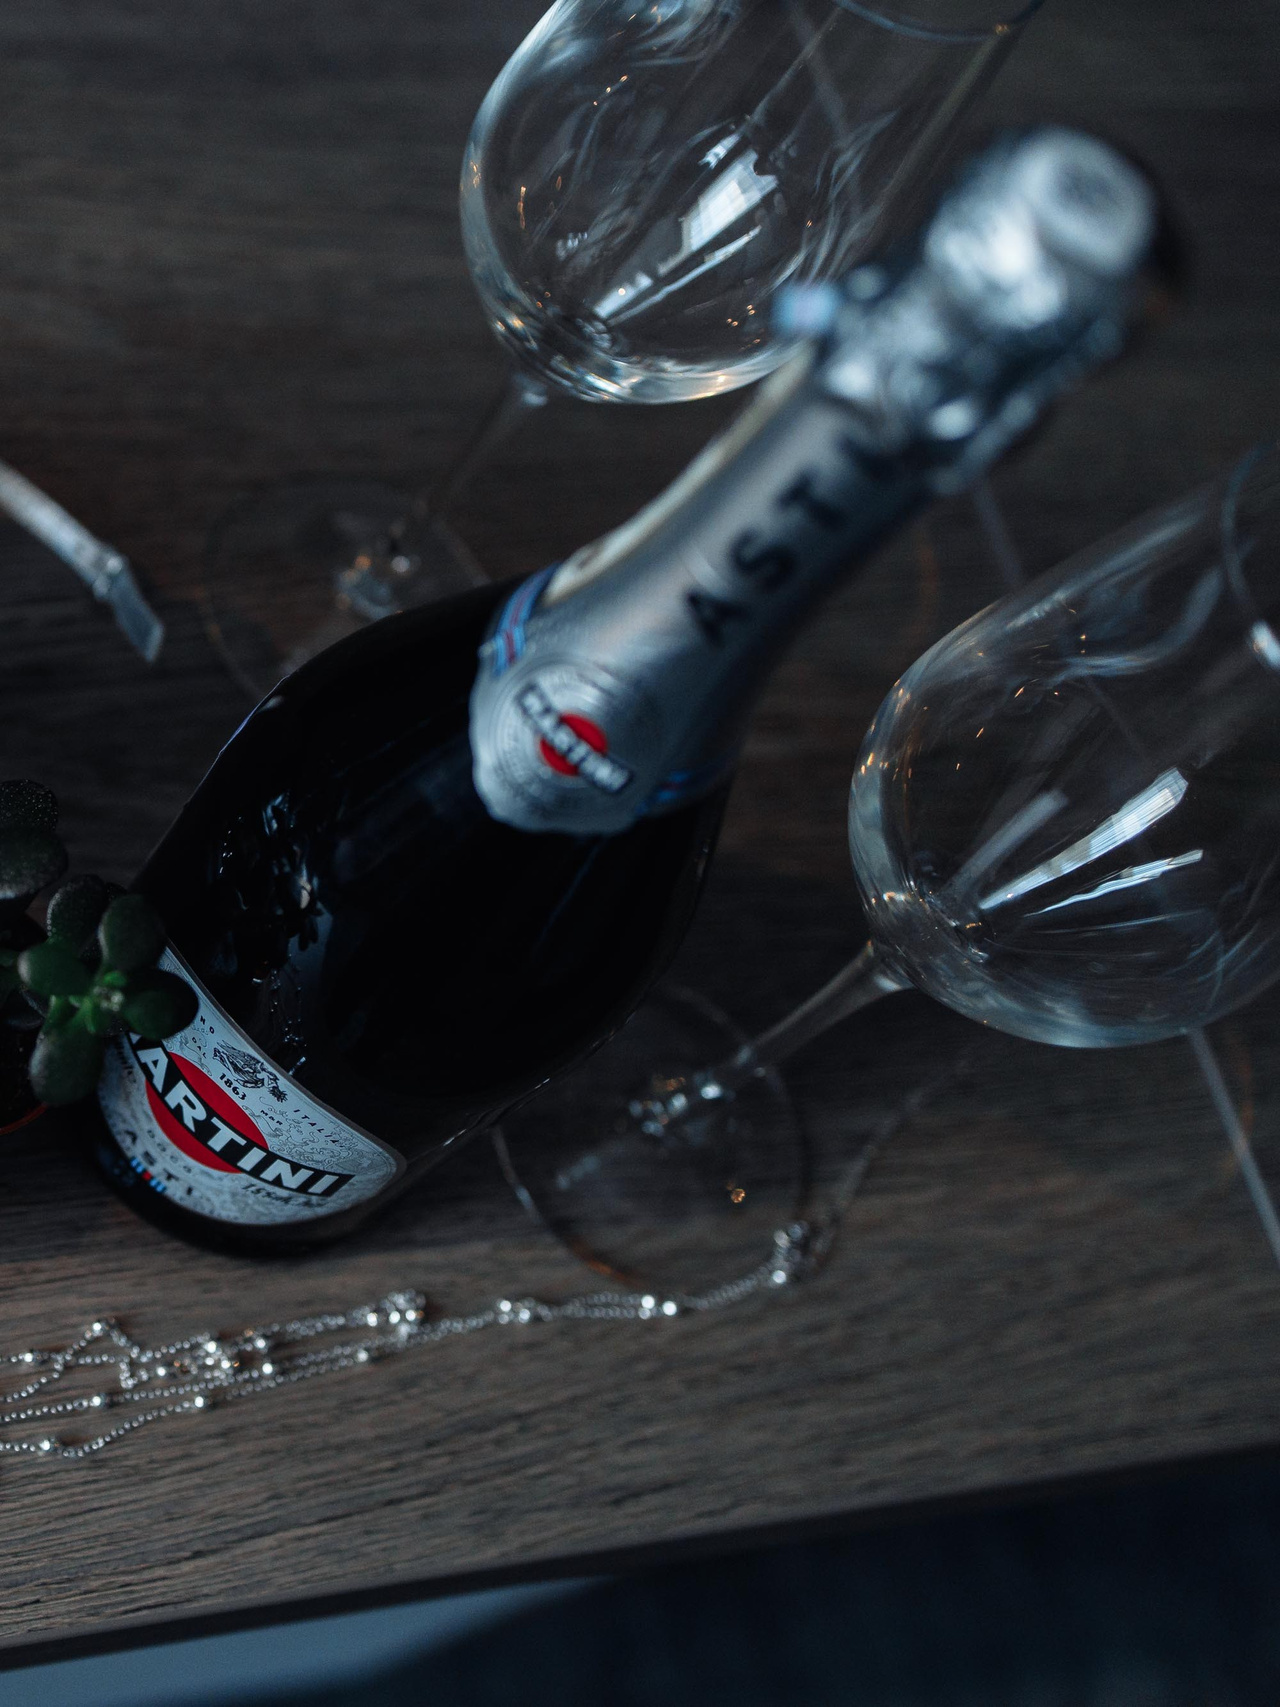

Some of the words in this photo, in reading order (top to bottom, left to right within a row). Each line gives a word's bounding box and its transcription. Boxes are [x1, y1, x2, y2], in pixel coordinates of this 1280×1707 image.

[218, 1073, 247, 1101] 1863
[130, 1032, 340, 1196] ARTINI
[293, 1108, 341, 1145] ITALIA
